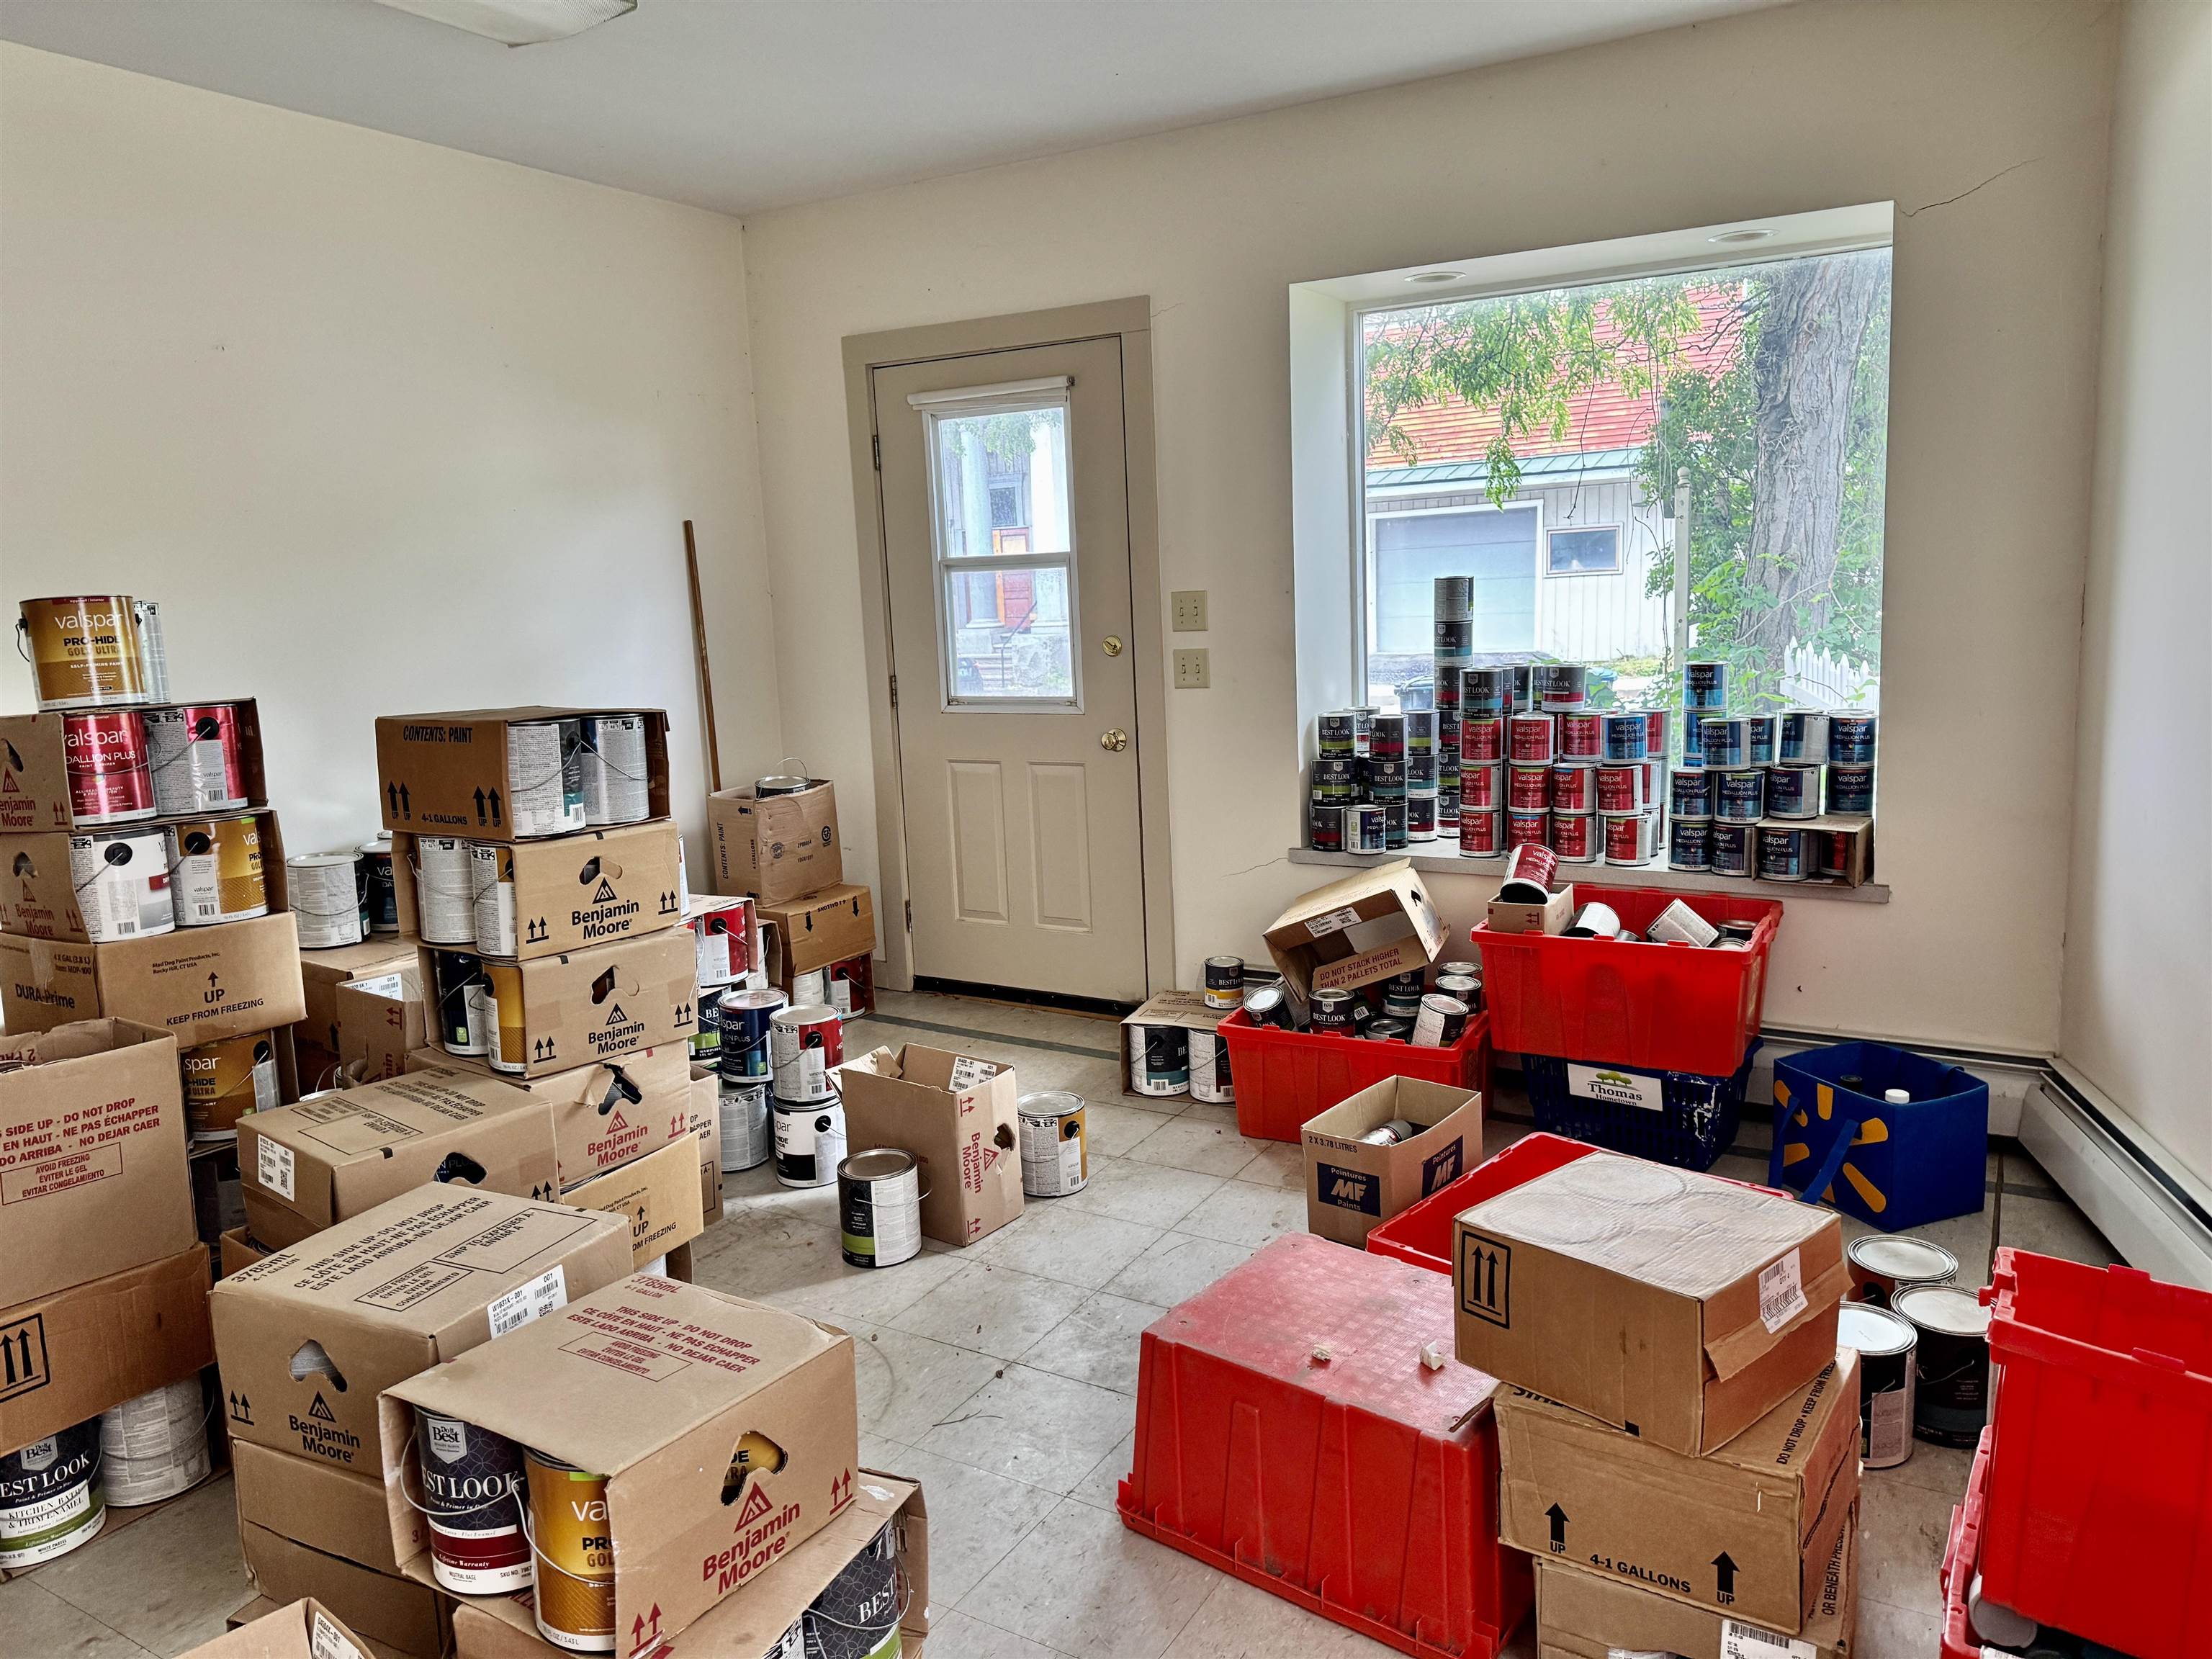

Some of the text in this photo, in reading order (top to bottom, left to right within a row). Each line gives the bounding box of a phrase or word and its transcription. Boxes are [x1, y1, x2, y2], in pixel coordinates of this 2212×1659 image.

[55, 610, 123, 631] valspar
[1688, 670, 1714, 680] valspar
[403, 725, 472, 743] CONTENTS: PAINT
[1468, 725, 1493, 734] valspar
[1615, 722, 1642, 732] valspar
[1704, 727, 1728, 737] valspar
[1838, 724, 1867, 734] valspar
[114, 750, 135, 760] PLUS
[1518, 773, 1544, 782] valspar
[1599, 774, 1622, 783] valspar
[1675, 778, 1701, 788] valspar
[1726, 780, 1755, 789] valspar
[1838, 774, 1867, 783] valspar
[1, 813, 32, 826] Moore
[392, 811, 399, 819] UP
[433, 815, 468, 826] GALLONS
[478, 817, 501, 827] UP UP
[1513, 820, 1539, 829] valspar
[1680, 828, 1708, 837] valspar
[1763, 836, 1789, 845] valspar
[15, 904, 54, 922] Benjamin
[572, 899, 639, 927] Benjamin
[26, 921, 53, 935] Moore
[583, 919, 629, 940] Moore
[1320, 948, 1399, 981] DO NOT STACK HIGHER
[1321, 978, 1339, 989] THAN
[1348, 966, 1378, 982] PALLETS
[1379, 958, 1403, 970] TOTAL
[15, 984, 75, 1008] DURA-Prime
[204, 989, 225, 1003] UP
[1389, 984, 1404, 992] BEST
[167, 998, 264, 1026] KEEP FROM FREEZING
[1313, 1013, 1327, 1022] BEST
[588, 1022, 644, 1044] Benjamin
[597, 1035, 637, 1055] Moore
[1587, 1083, 1642, 1101] Thomas
[1596, 1094, 1637, 1106] Hometown
[6, 1098, 135, 1137] SIDE UP DO NOT DROP
[3, 1105, 158, 1151] EN HAUT NE PAS ÉCHAPPER
[19, 1118, 160, 1162] ARRIBA NO DEJAR CAER
[588, 1125, 648, 1156] Benjamin
[1320, 1138, 1334, 1148] 3.78
[1335, 1141, 1357, 1153] LITRES
[597, 1142, 638, 1166] Moore
[1433, 1144, 1456, 1165] Peintures
[36, 1154, 90, 1174] AVOID FREEZING
[962, 1146, 972, 1190] Moore
[971, 1132, 986, 1195] Benjamin
[1331, 1167, 1367, 1182] Peintures
[1431, 1155, 1455, 1192] MF
[22, 1169, 104, 1197] EVITAR CONGELAMIENTO
[1331, 1179, 1367, 1201] MF
[1337, 1199, 1361, 1211] Paints
[304, 1258, 335, 1272] THIS
[333, 1244, 361, 1258] SIDE
[395, 1217, 418, 1228] NOT
[417, 1203, 445, 1218] DROP
[480, 1228, 516, 1247] ENVIAR
[634, 1220, 649, 1237] UP
[644, 1222, 676, 1245] FREEZING
[294, 1279, 314, 1288] CE
[343, 1254, 362, 1264] EN
[406, 1220, 431, 1231] PAS
[310, 1274, 343, 1291] ESTE
[341, 1259, 374, 1275] LADO
[431, 1213, 467, 1230] DEJAR
[464, 1200, 493, 1213] CAER
[444, 1246, 469, 1259] SHIP
[231, 1254, 295, 1282] 3785mL
[544, 1273, 553, 1282] 001
[631, 1276, 683, 1294] 3785mL
[636, 1288, 665, 1298] GALLON
[616, 1306, 640, 1316] THIS
[638, 1313, 665, 1322] SIDE
[698, 1330, 724, 1339] NOT
[719, 1337, 752, 1349] DROP
[1776, 1377, 1825, 1465] DO NOT DROP KEEP FROM
[289, 1412, 360, 1450] Benjamin
[433, 1426, 460, 1443] Best
[303, 1435, 352, 1463] Moore
[41, 1449, 90, 1488] LOOK
[450, 1473, 519, 1499] LOOK
[703, 1501, 800, 1581] Benjamin
[1550, 1541, 1565, 1554] UP
[717, 1535, 786, 1596] Moore
[1590, 1554, 1691, 1593] 4-1 GALLONS
[1825, 1557, 1840, 1602] BENEATH
[858, 1573, 896, 1624] BEST
[1717, 1592, 1735, 1606] UP
[1821, 1600, 1835, 1616] OR
